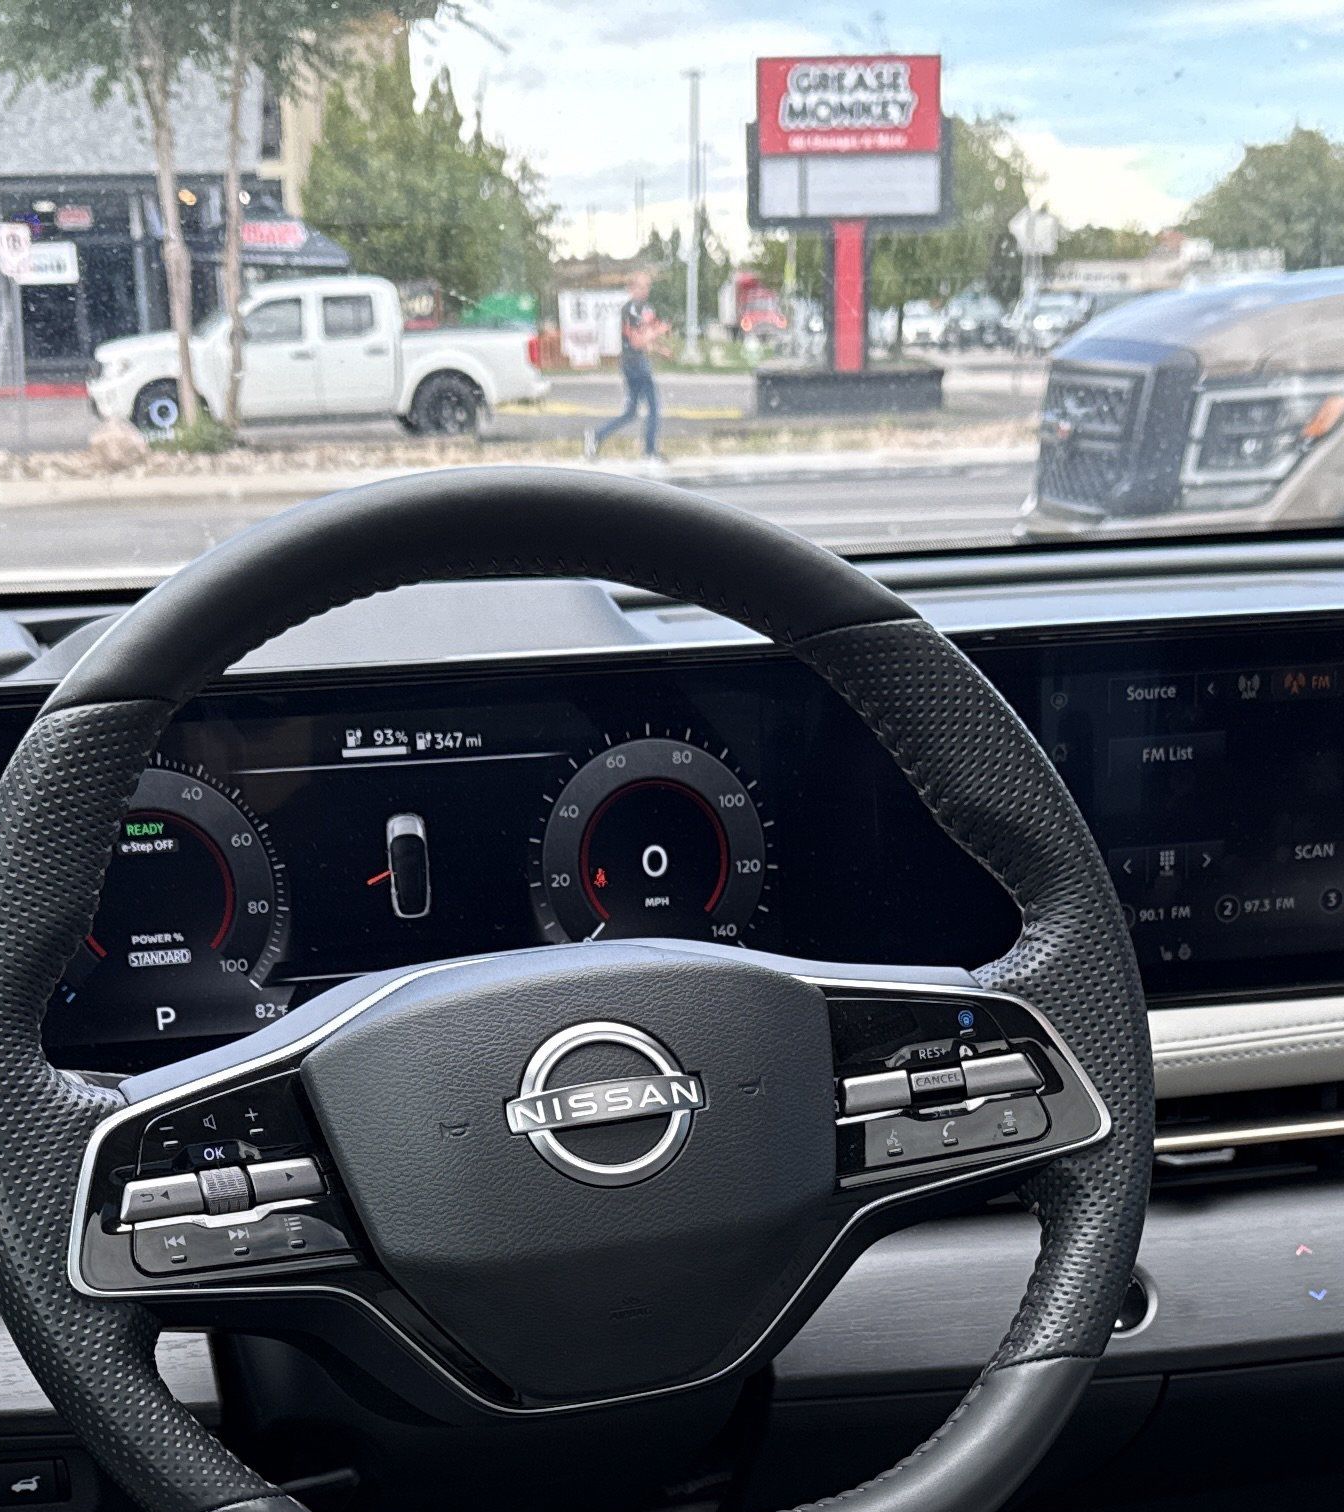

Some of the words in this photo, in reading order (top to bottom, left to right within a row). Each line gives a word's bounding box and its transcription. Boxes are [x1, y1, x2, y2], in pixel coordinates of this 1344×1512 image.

[793, 68, 907, 95] GREASE
[785, 97, 909, 124] MONKEY
[1311, 674, 1330, 690] FM
[1126, 684, 1177, 701] Source
[373, 729, 408, 746] 93%
[434, 732, 463, 749] 347
[606, 755, 626, 768] 60
[672, 750, 693, 765] 80
[1142, 747, 1165, 763] FM
[1169, 746, 1193, 761] List
[181, 786, 203, 801] 40
[718, 793, 745, 808] 100
[559, 804, 579, 818] 40
[125, 822, 165, 837] READY
[121, 841, 153, 854] e-Step
[154, 839, 174, 851] OFF
[231, 832, 253, 848] 60
[1294, 842, 1335, 860] SCAN
[641, 844, 668, 877] 0
[736, 859, 761, 874] 120
[551, 873, 570, 887] 20
[644, 896, 670, 907] MPH
[1222, 901, 1234, 916] 2
[1244, 899, 1270, 913] 97.3
[1275, 897, 1295, 911] FM
[1327, 892, 1338, 907] 3
[247, 900, 269, 915] 80
[1139, 907, 1164, 922] 90.1
[1171, 905, 1191, 920] FM
[711, 923, 737, 937] 140
[131, 933, 172, 946] POWER
[173, 932, 185, 943] %
[129, 949, 191, 967] STANDARD
[219, 958, 249, 973] 100
[156, 1006, 176, 1031] P
[915, 1072, 961, 1087] CANCEL
[514, 1080, 699, 1129] NISSAN
[203, 1145, 226, 1161] OK
